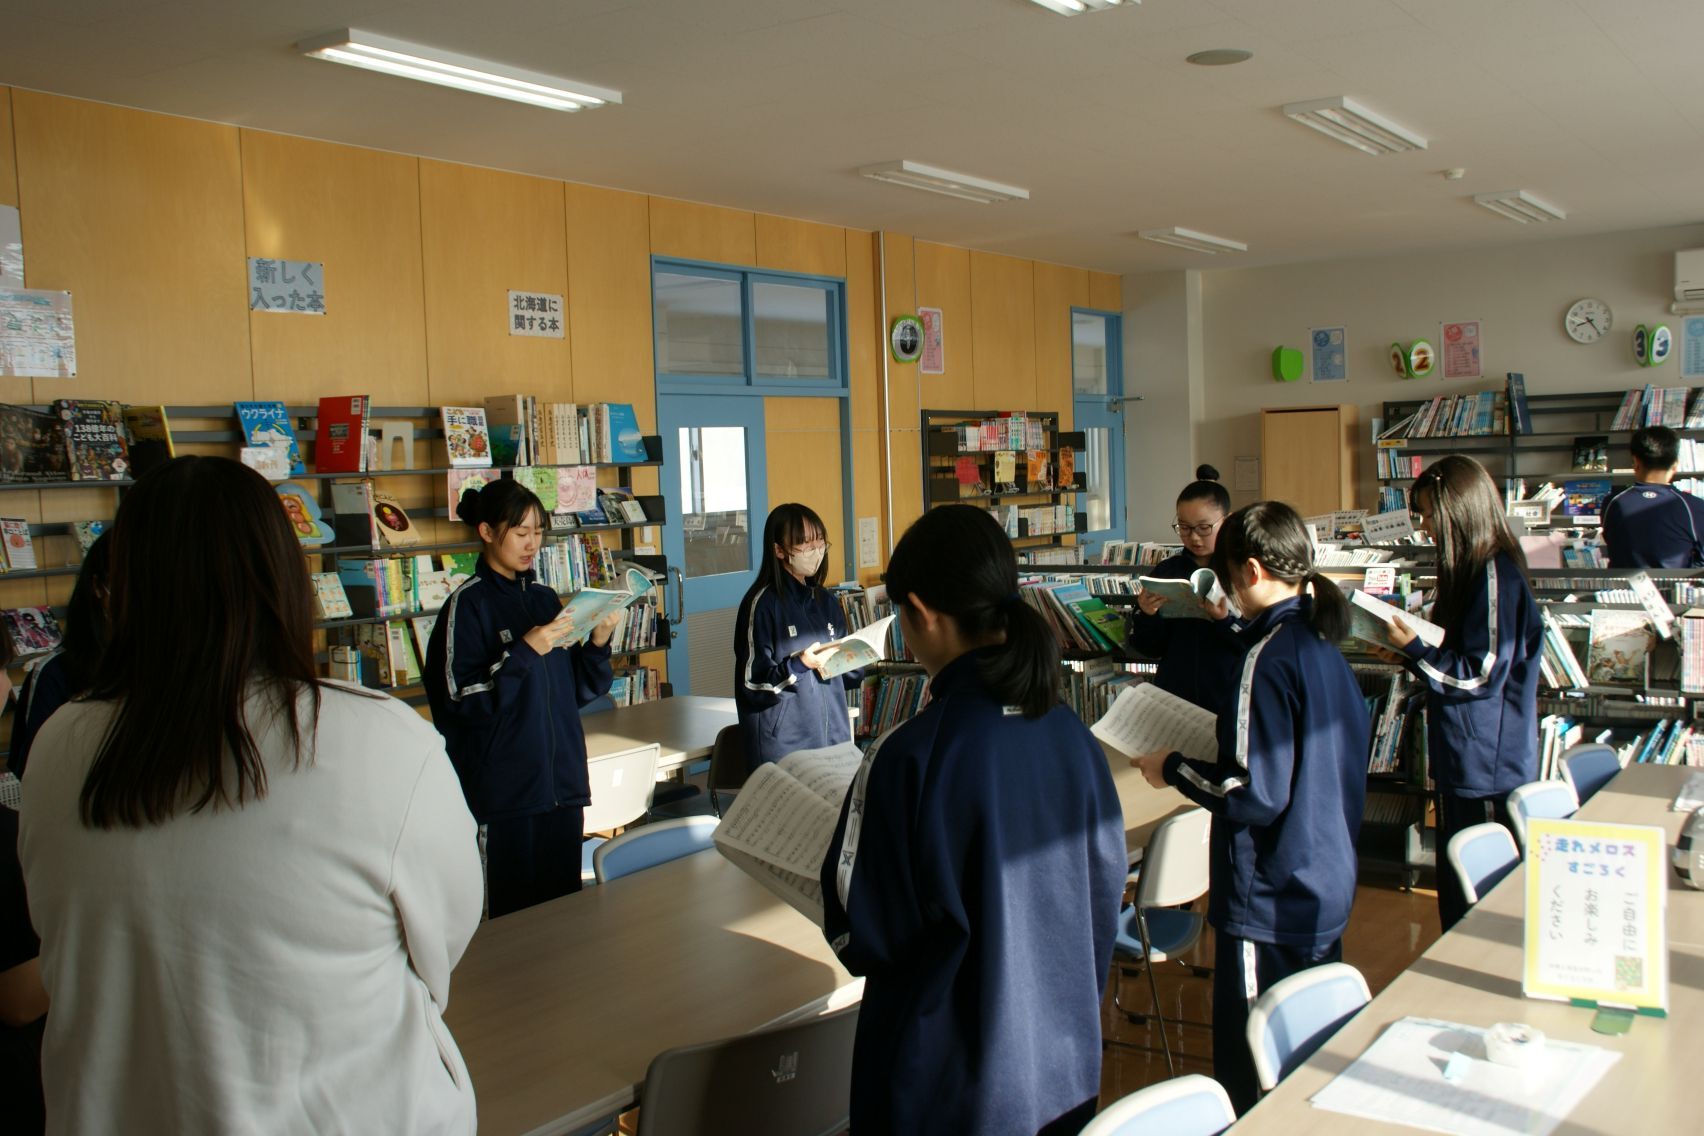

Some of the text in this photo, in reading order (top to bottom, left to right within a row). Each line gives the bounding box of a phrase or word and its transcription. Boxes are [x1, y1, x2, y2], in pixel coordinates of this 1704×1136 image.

[255, 258, 315, 286] 新しく
[250, 286, 325, 313] 入った本
[513, 295, 559, 312] 北海道に
[514, 314, 560, 332] 関する本
[1635, 329, 1646, 358] 3
[1413, 347, 1431, 372] 2
[240, 408, 285, 420] ウクライナ
[72, 433, 118, 442] こども大百科
[74, 424, 116, 433] 138億年の
[1555, 838, 1635, 857] 走れメロス
[1568, 861, 1625, 878] すごろく
[1549, 884, 1564, 940] ください
[1584, 887, 1599, 946] お楽しみ
